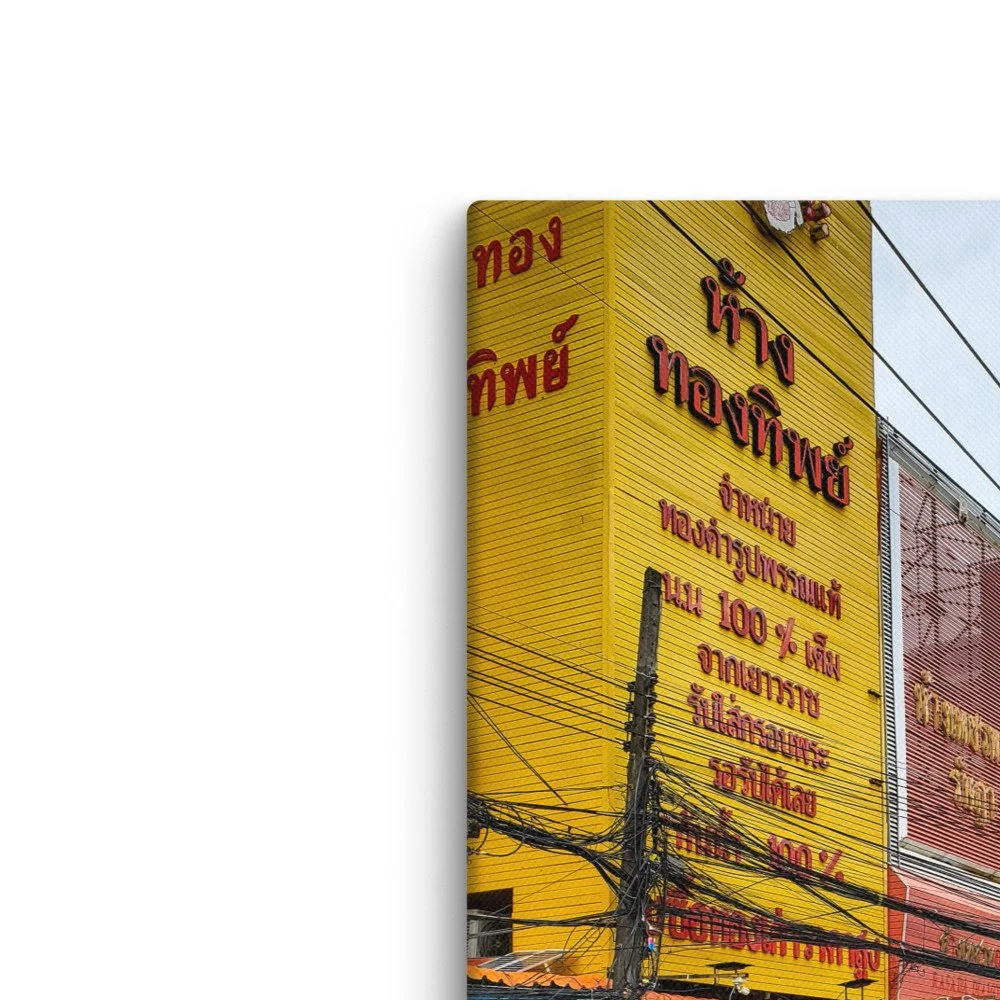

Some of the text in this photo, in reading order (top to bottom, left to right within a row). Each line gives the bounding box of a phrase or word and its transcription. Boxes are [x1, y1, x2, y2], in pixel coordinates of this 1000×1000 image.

[471, 215, 563, 288] ทอง
[467, 314, 580, 416] ทิพย์
[701, 257, 795, 386] ห้าง
[646, 334, 854, 509] ทองทิพย์
[718, 472, 797, 547] จำหน่าย
[697, 642, 821, 719] จากเยาวราช
[718, 590, 768, 645] 100
[775, 617, 797, 659] %
[805, 632, 841, 681] เต็ม
